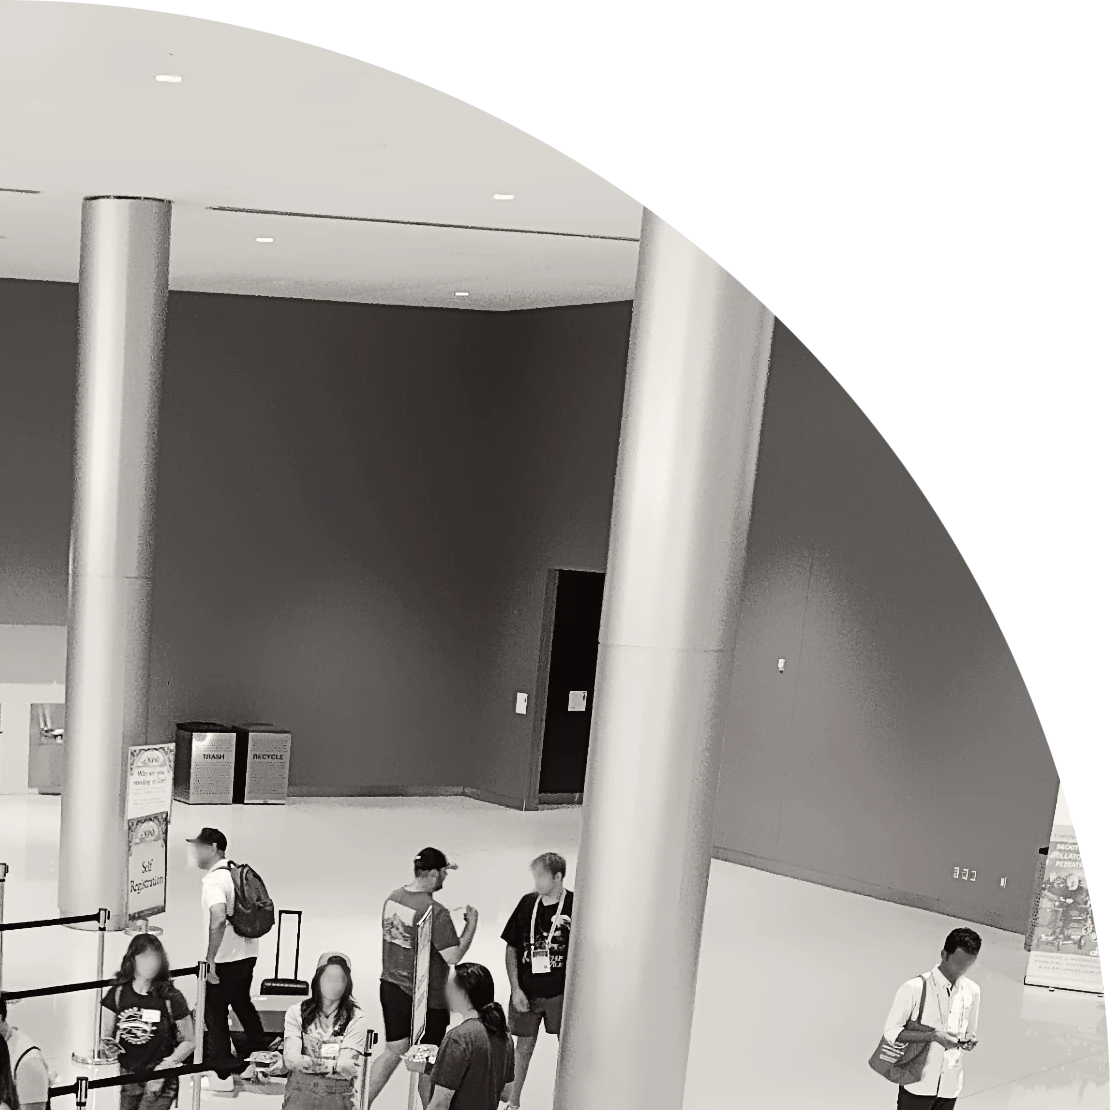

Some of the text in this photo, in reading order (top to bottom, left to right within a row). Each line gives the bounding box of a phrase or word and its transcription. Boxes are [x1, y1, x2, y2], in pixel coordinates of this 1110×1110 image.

[1056, 843, 1081, 851] SCOOT
[1050, 851, 1082, 860] ROLLATO
[141, 858, 154, 874] Self
[130, 875, 164, 895] Registration
